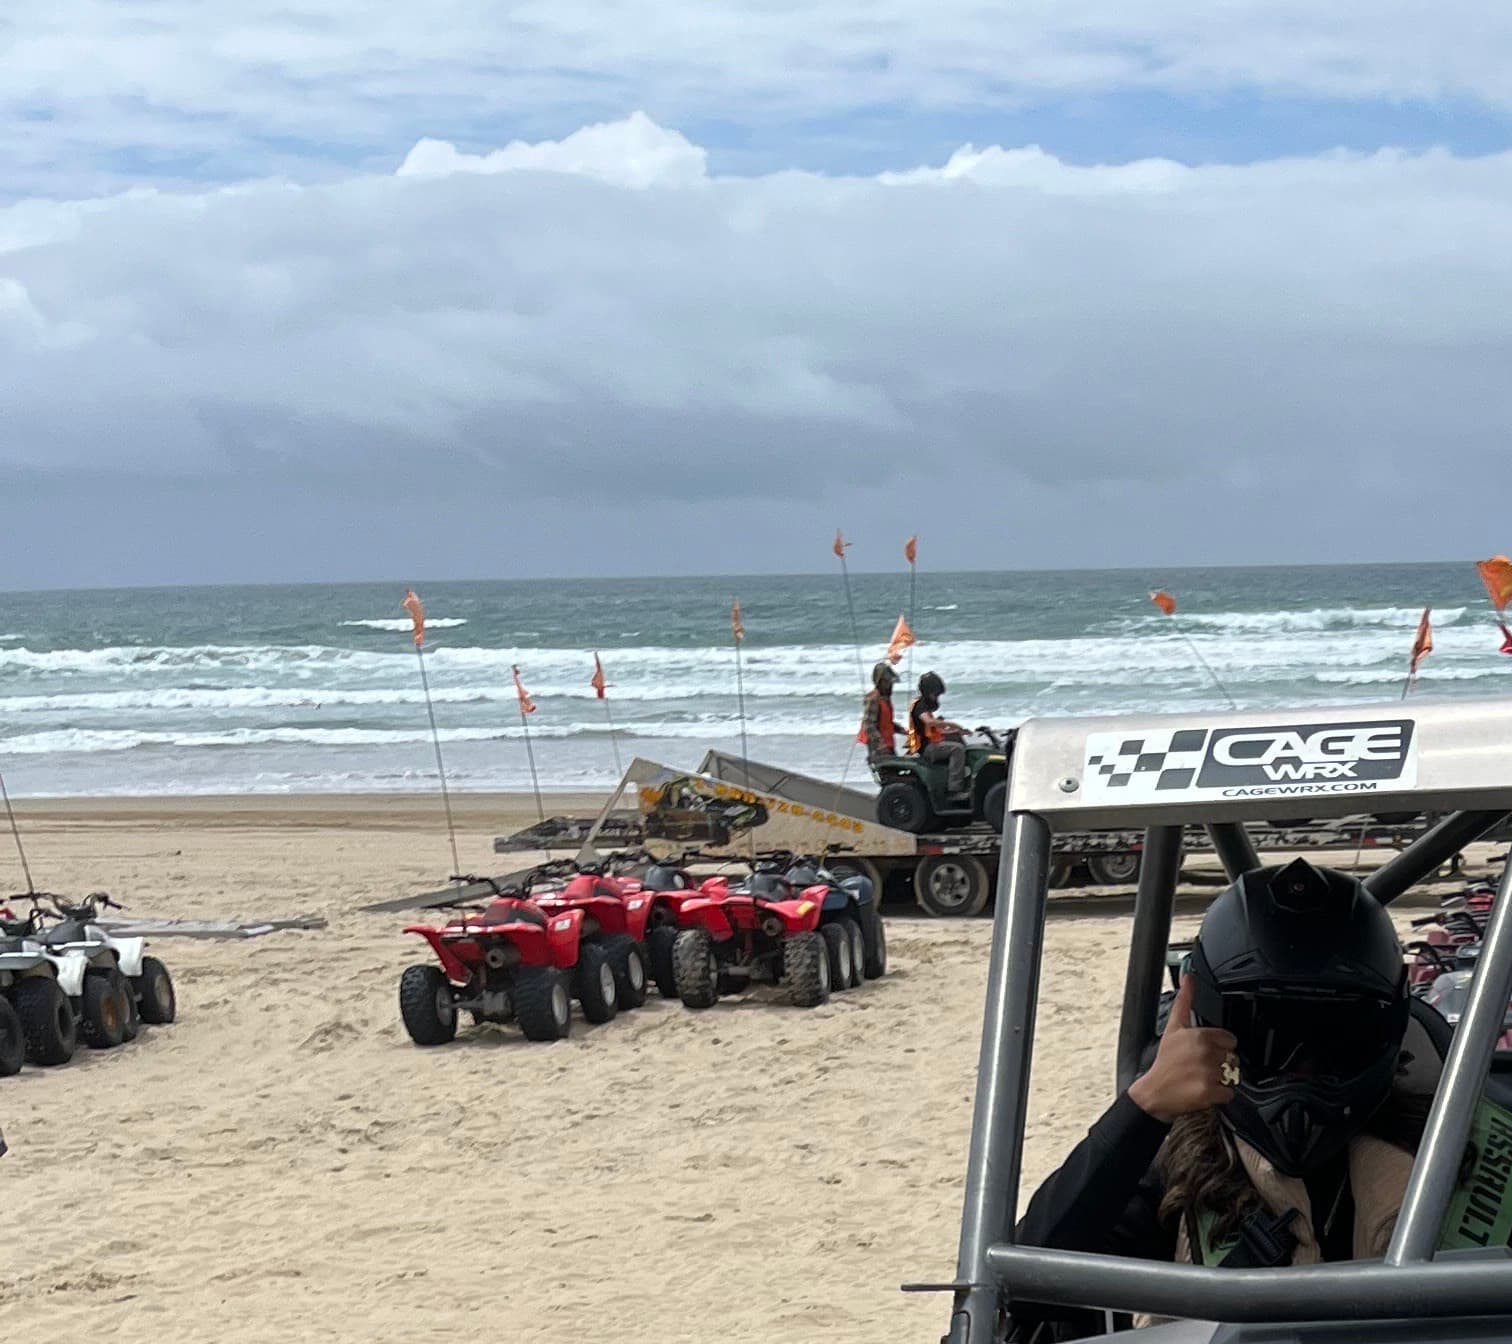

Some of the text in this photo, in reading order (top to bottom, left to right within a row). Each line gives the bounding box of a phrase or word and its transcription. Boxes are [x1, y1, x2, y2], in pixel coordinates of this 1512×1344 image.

[1213, 726, 1401, 766] CAGE
[1262, 762, 1358, 781] WRX
[1222, 782, 1378, 797] CAGEWRX.COM
